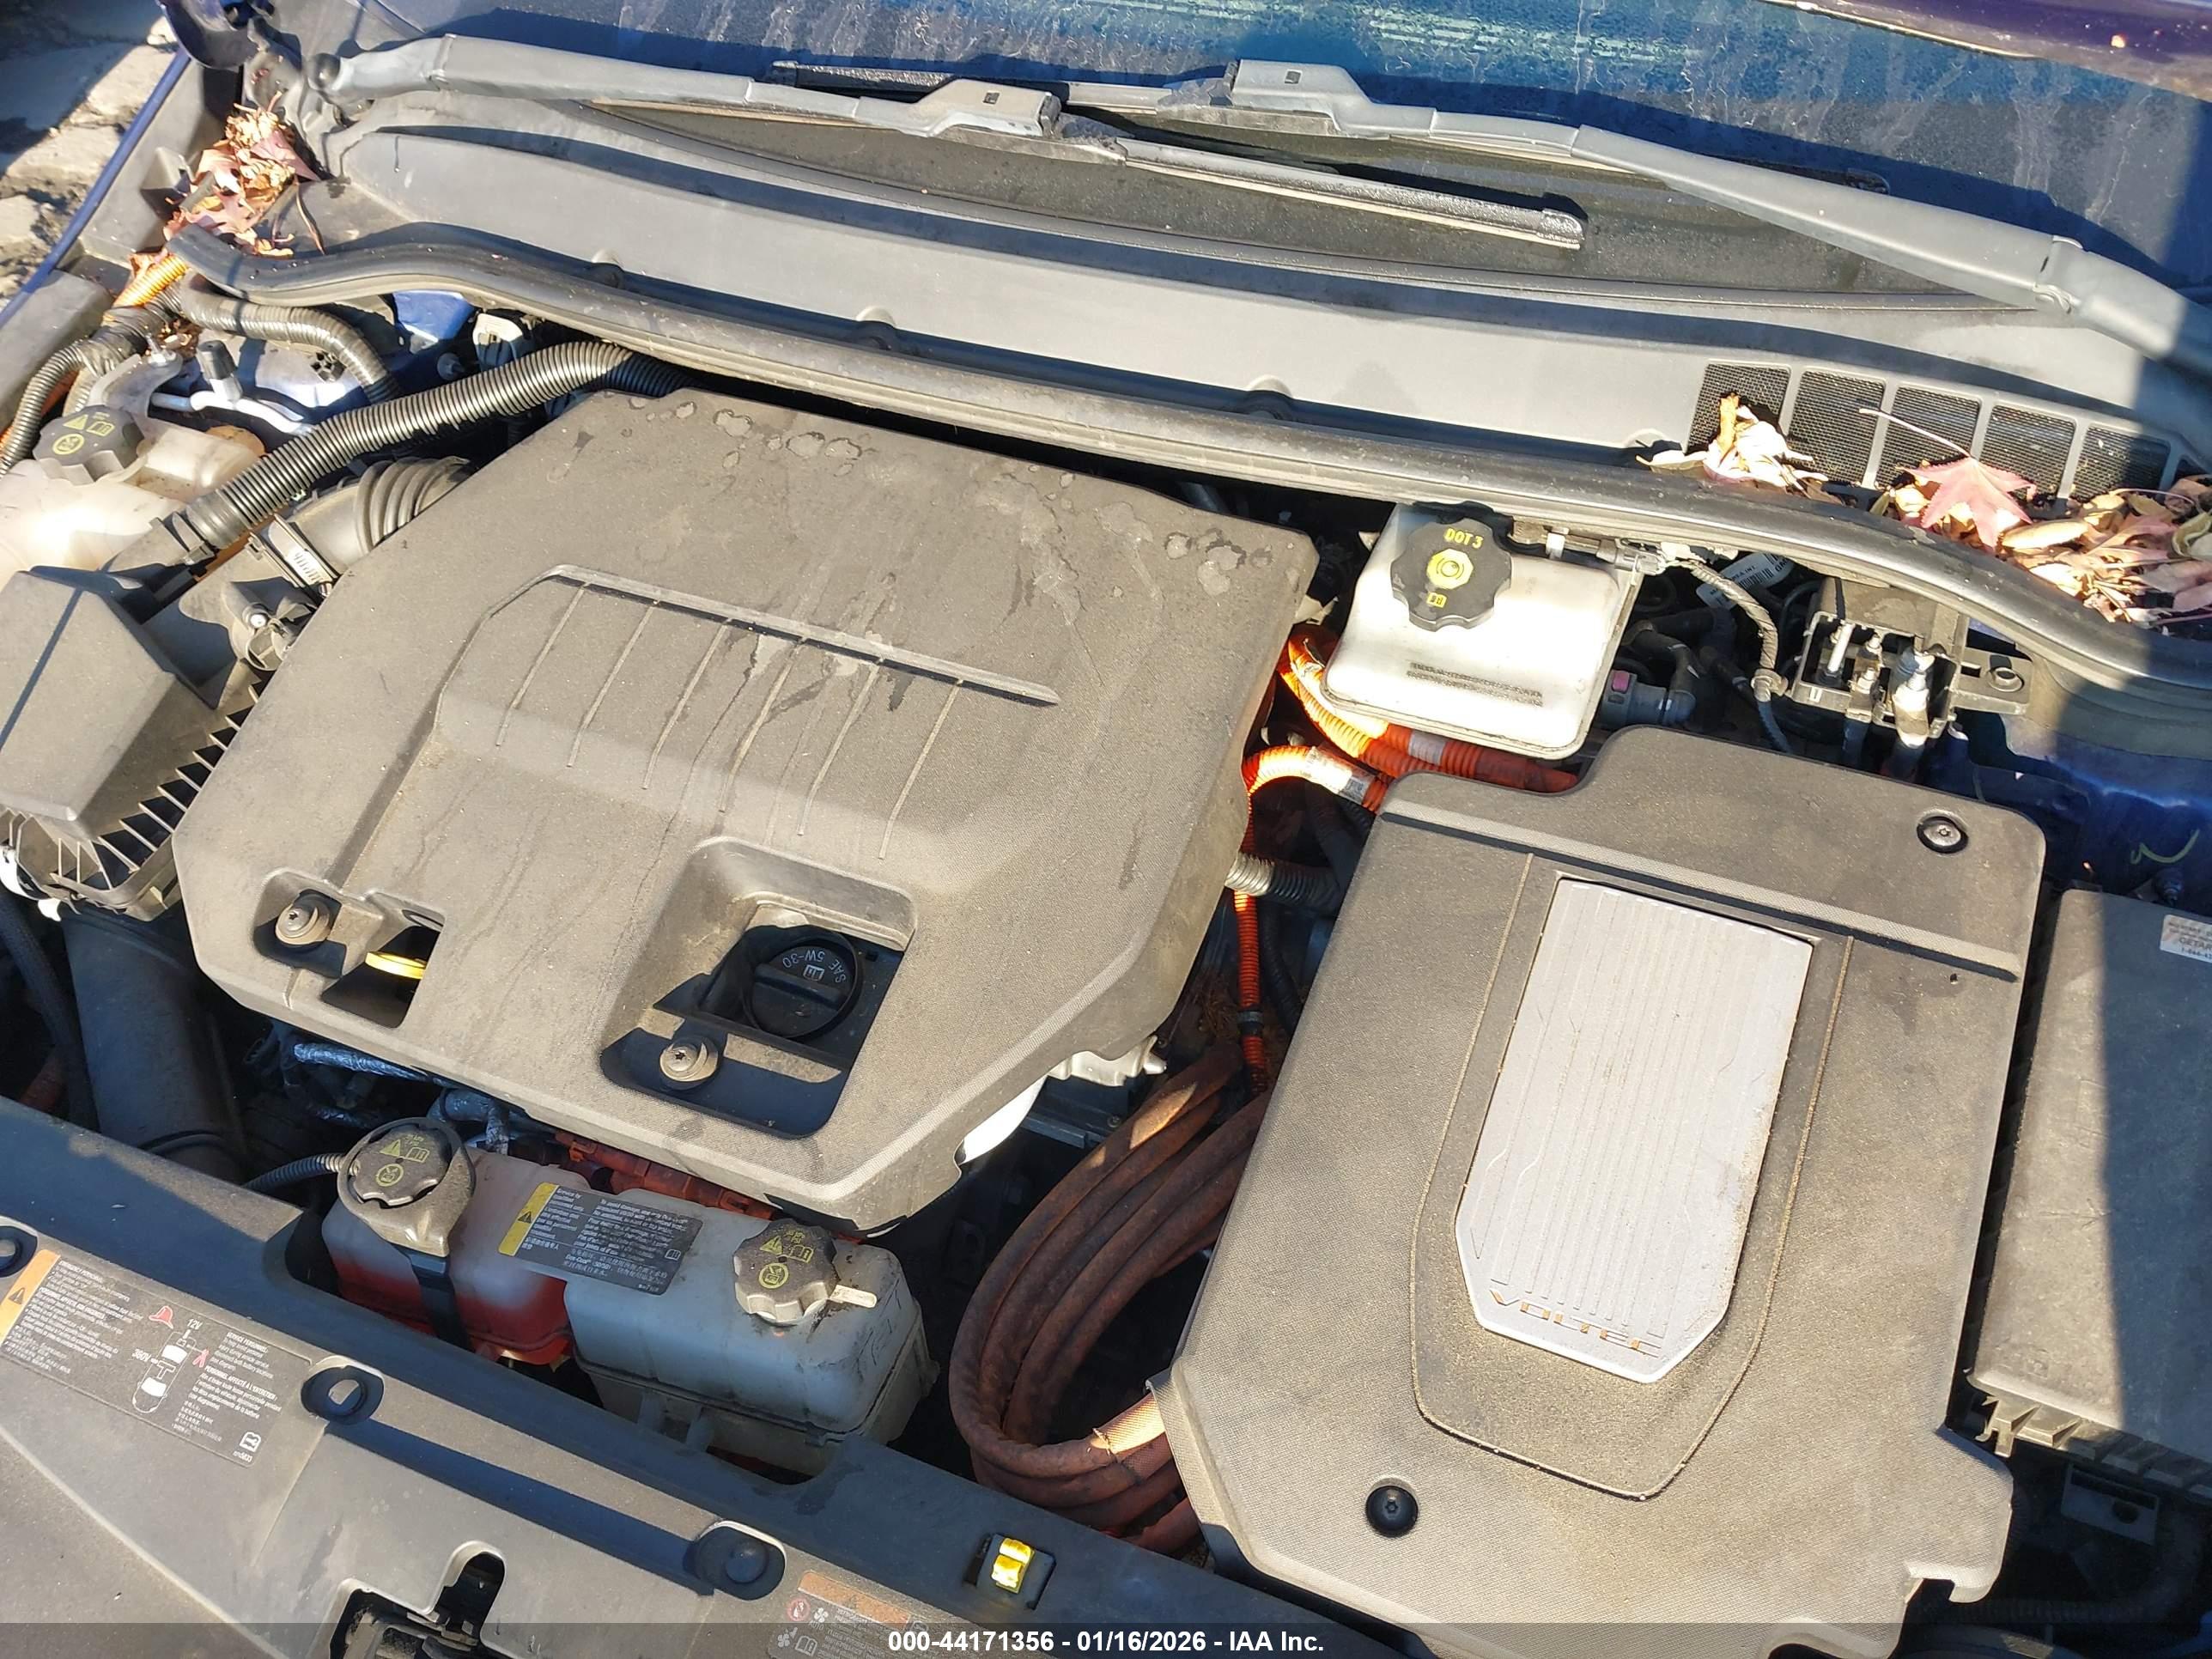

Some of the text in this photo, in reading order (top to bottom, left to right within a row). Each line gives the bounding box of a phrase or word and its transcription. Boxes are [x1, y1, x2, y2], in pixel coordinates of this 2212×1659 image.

[1444, 527, 1484, 549] DOT 3
[781, 949, 847, 984] SAE 5W-30
[186, 1318, 204, 1331] 12V
[1489, 1288, 1663, 1358] VOLTEC
[131, 1348, 153, 1363] 360V
[204, 1365, 228, 1379] PERSONNEL
[808, 1620, 825, 1632] AUTO
